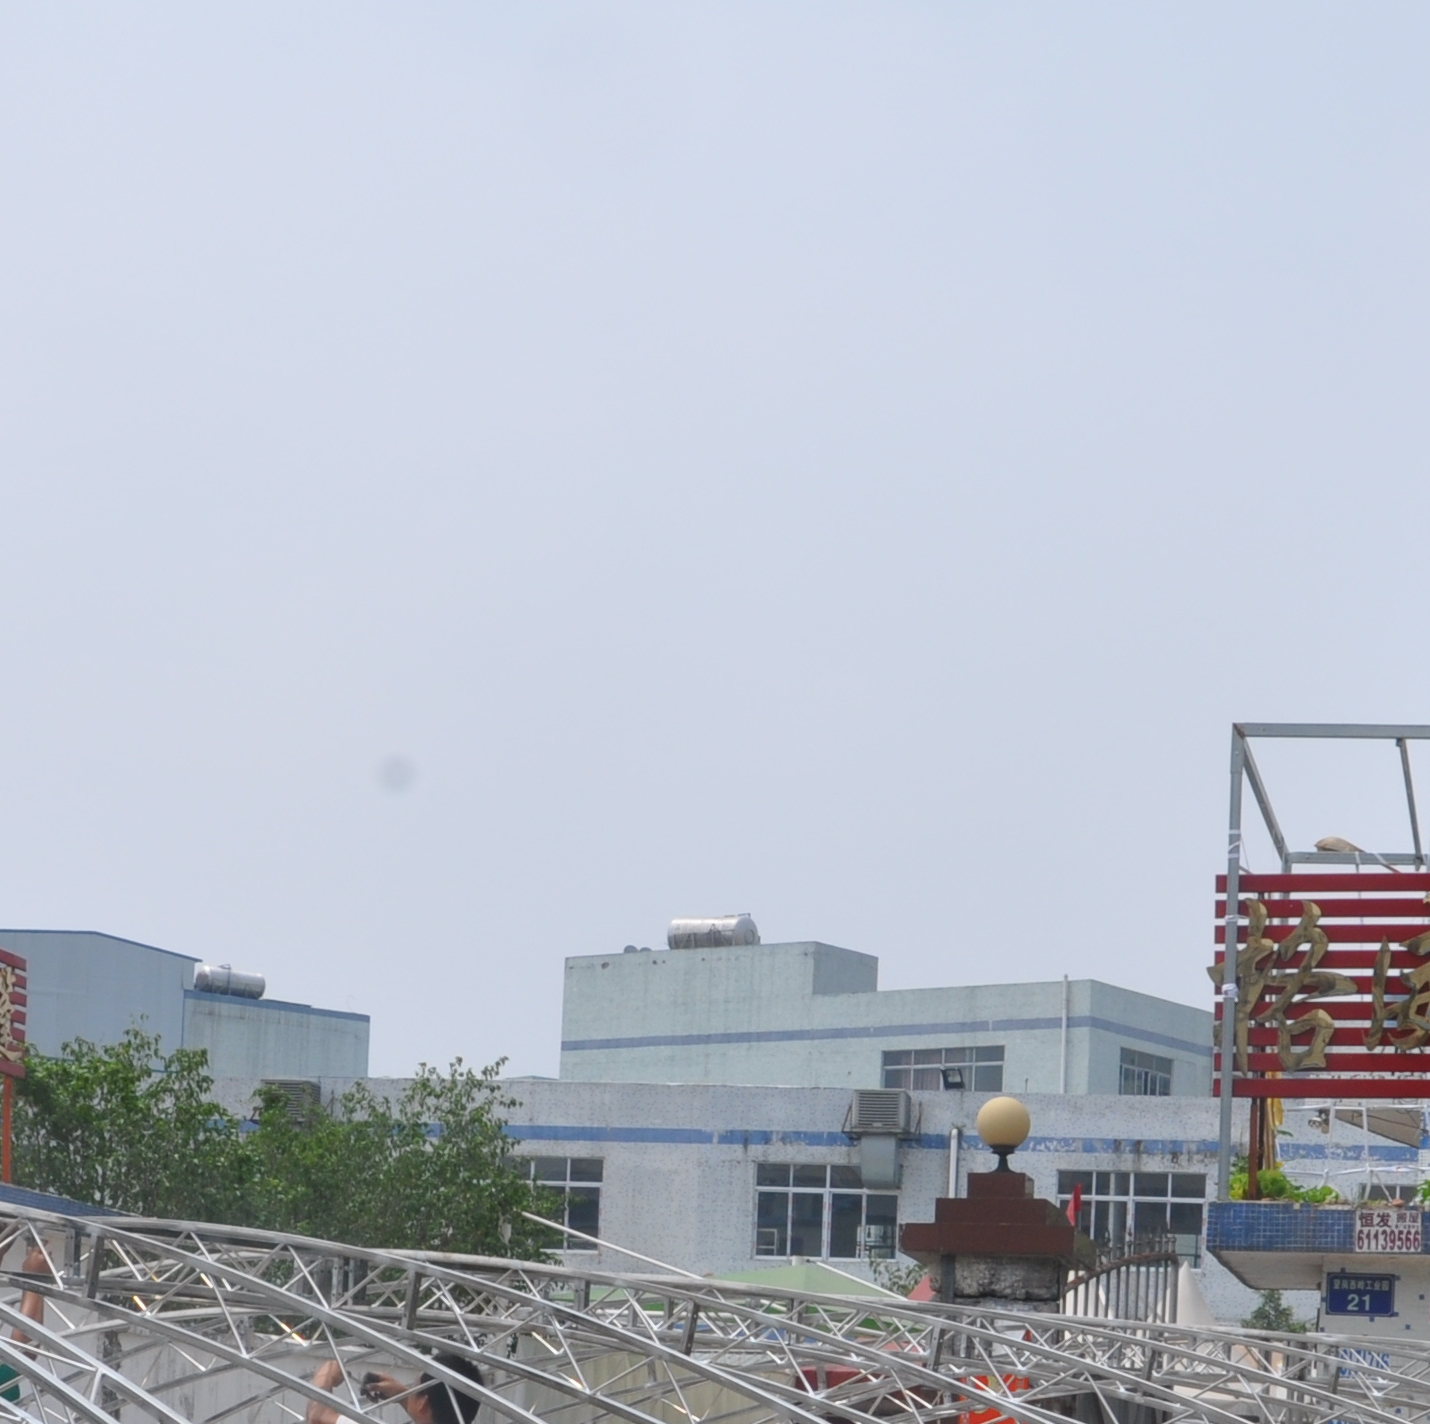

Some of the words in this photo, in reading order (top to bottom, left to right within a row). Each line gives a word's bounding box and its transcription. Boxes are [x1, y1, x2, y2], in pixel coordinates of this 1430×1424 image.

[1359, 1212, 1392, 1229] 恒发
[1357, 1229, 1420, 1251] 61139566
[1347, 1294, 1371, 1311] 21
